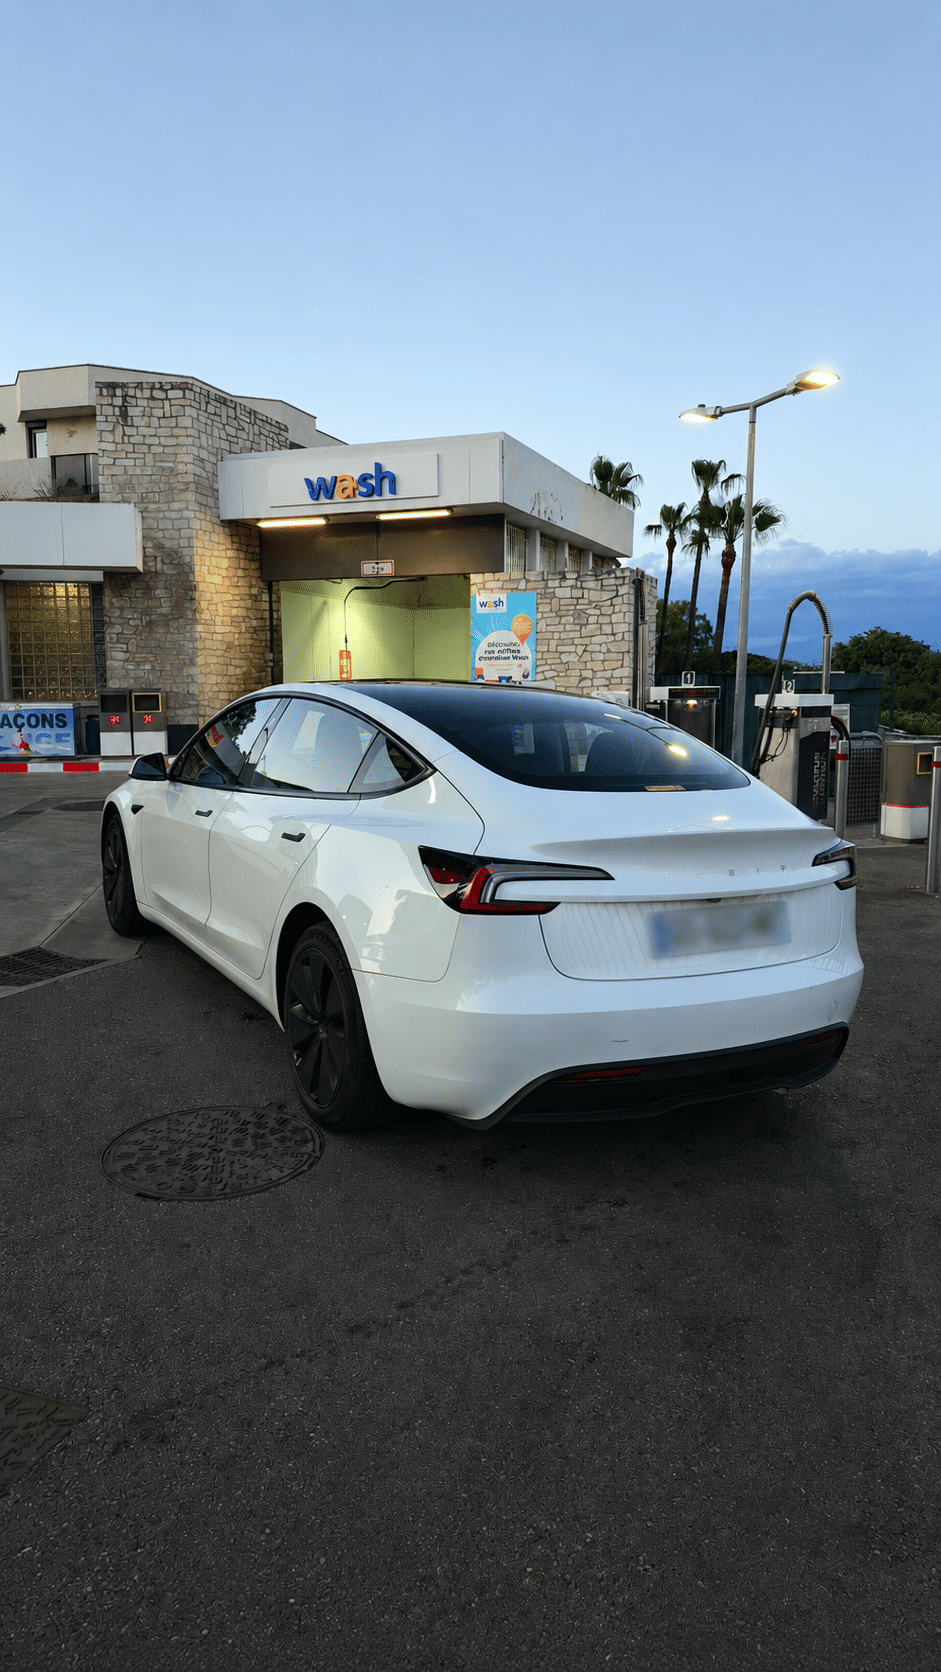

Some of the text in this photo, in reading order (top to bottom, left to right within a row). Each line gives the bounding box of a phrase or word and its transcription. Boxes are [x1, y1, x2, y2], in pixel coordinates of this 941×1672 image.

[304, 462, 397, 501] wash
[479, 597, 504, 608] wash
[686, 673, 691, 684] 1
[786, 681, 793, 692] 2
[0, 713, 68, 732] AÇONS
